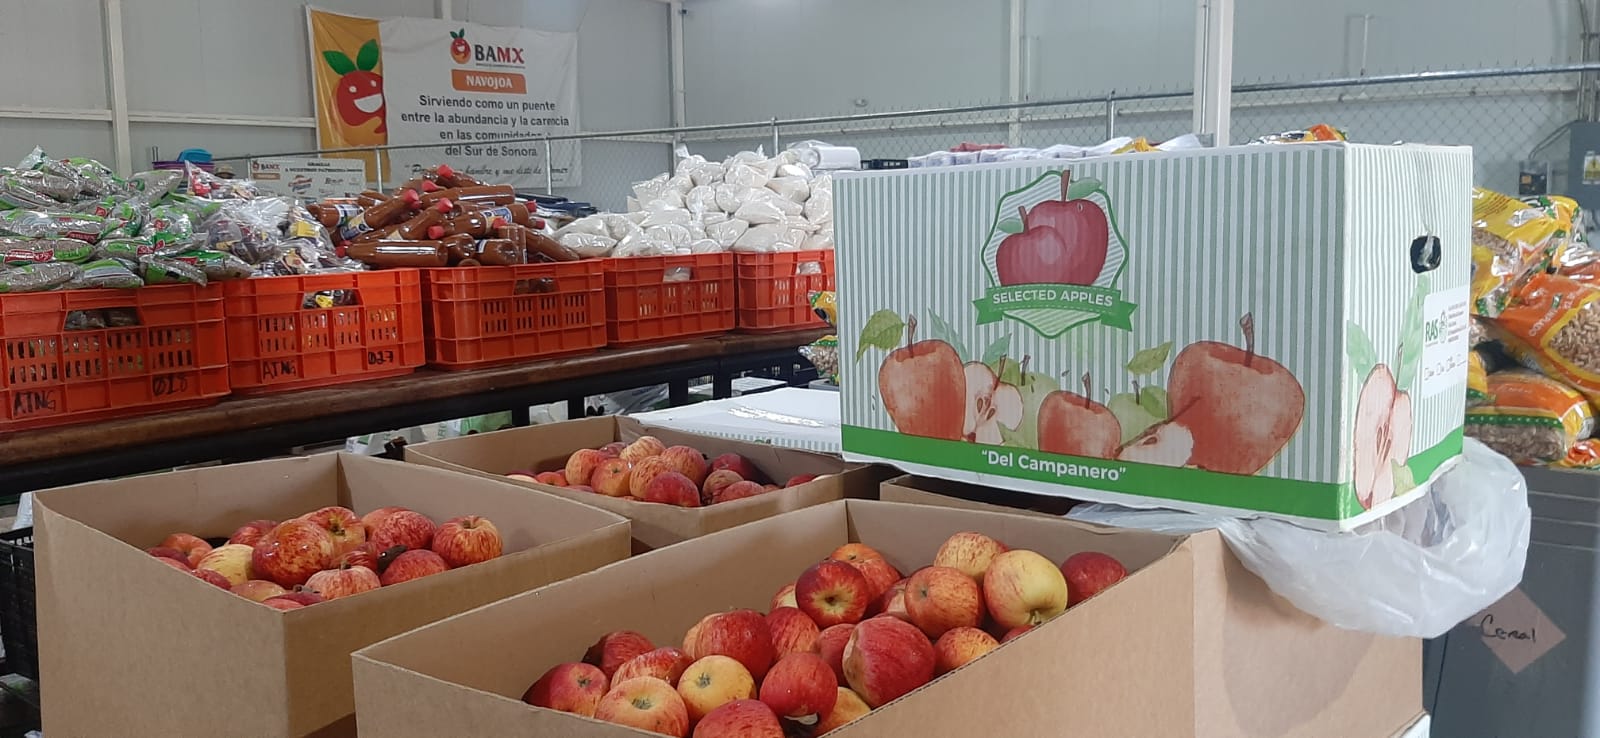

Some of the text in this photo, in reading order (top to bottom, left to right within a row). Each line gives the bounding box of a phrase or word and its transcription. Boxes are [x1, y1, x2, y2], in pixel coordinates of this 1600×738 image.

[474, 44, 525, 64] BAMX
[466, 75, 513, 89] NAVOJOA
[419, 95, 555, 112] Sirviendo como un puente
[401, 112, 569, 128] entre la abundancia y la carencia
[440, 131, 454, 139] en
[457, 129, 472, 140] las
[445, 145, 537, 156] del Sur de Sonora
[993, 289, 1113, 307] SELECTED APPLES
[1425, 318, 1439, 343] RAS
[1480, 614, 1536, 643] Cereal
